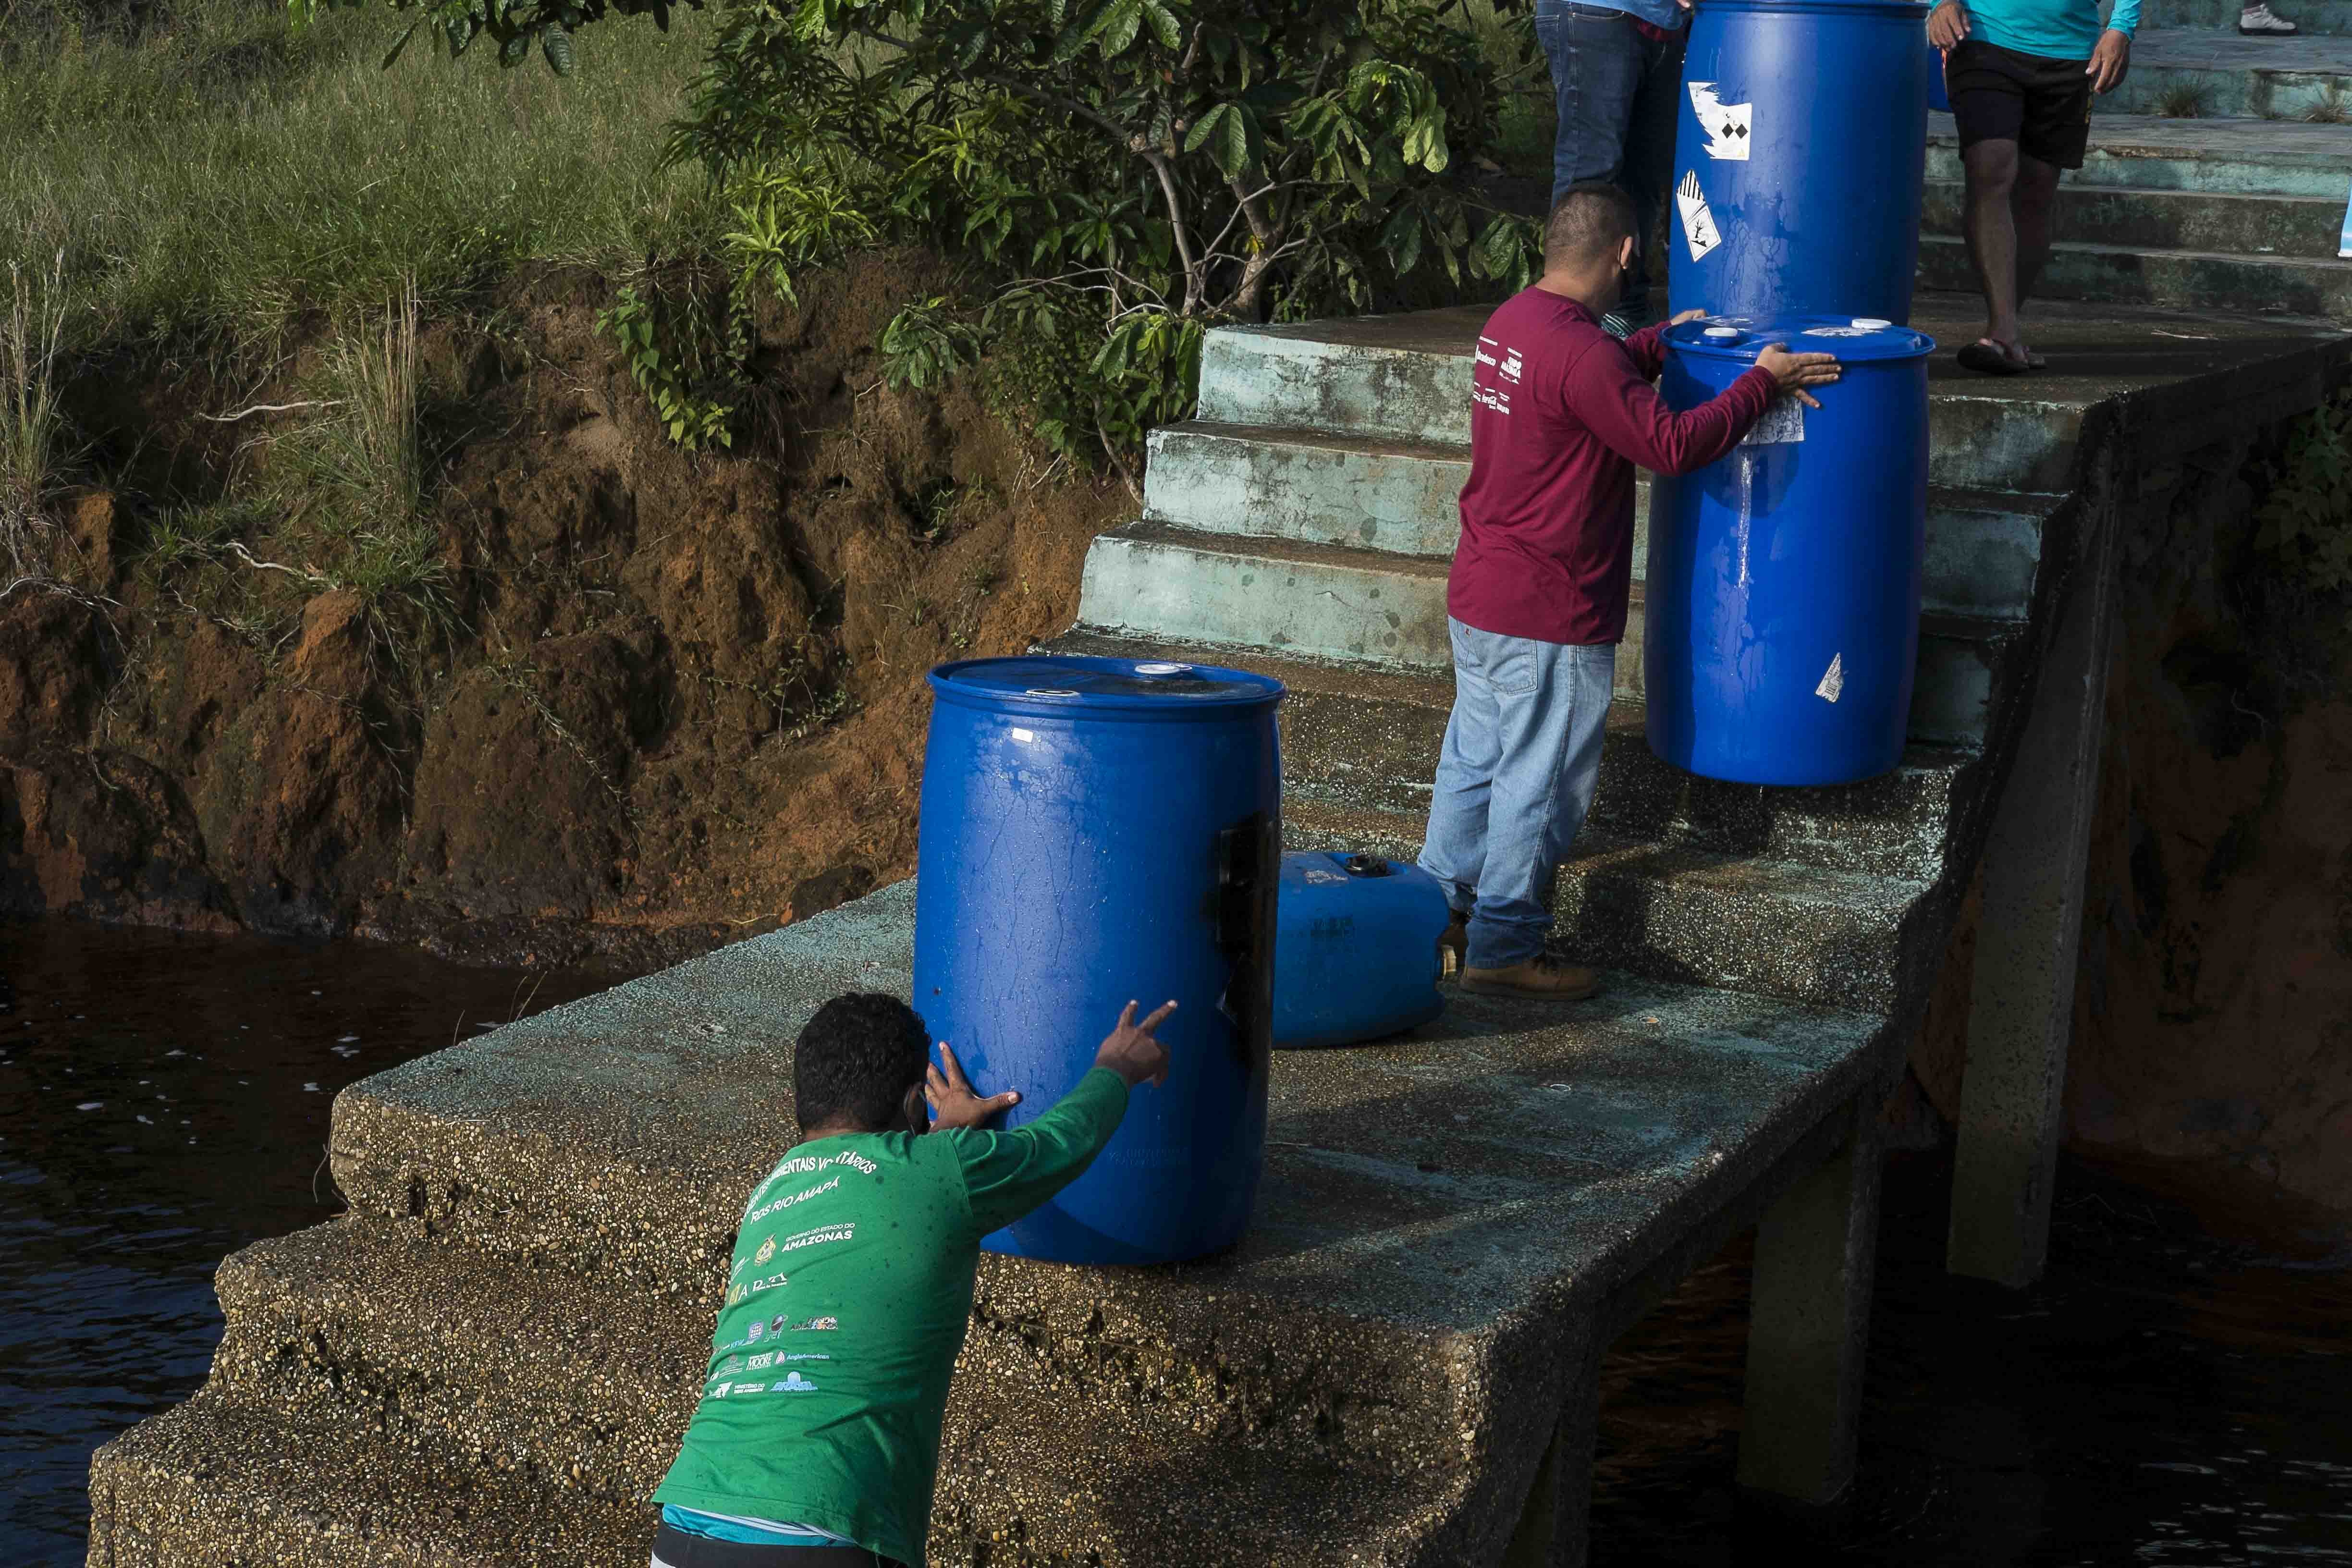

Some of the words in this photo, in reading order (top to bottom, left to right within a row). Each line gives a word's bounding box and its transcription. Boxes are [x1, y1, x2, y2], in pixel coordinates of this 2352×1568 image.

[750, 1204, 772, 1225] RDS
[771, 1196, 794, 1213] RIO
[794, 1176, 841, 1204] AMAPÁ
[782, 1230, 853, 1252] AMAZONAS
[786, 1230, 810, 1242] GOVERNO
[746, 1356, 772, 1370] MOORE
